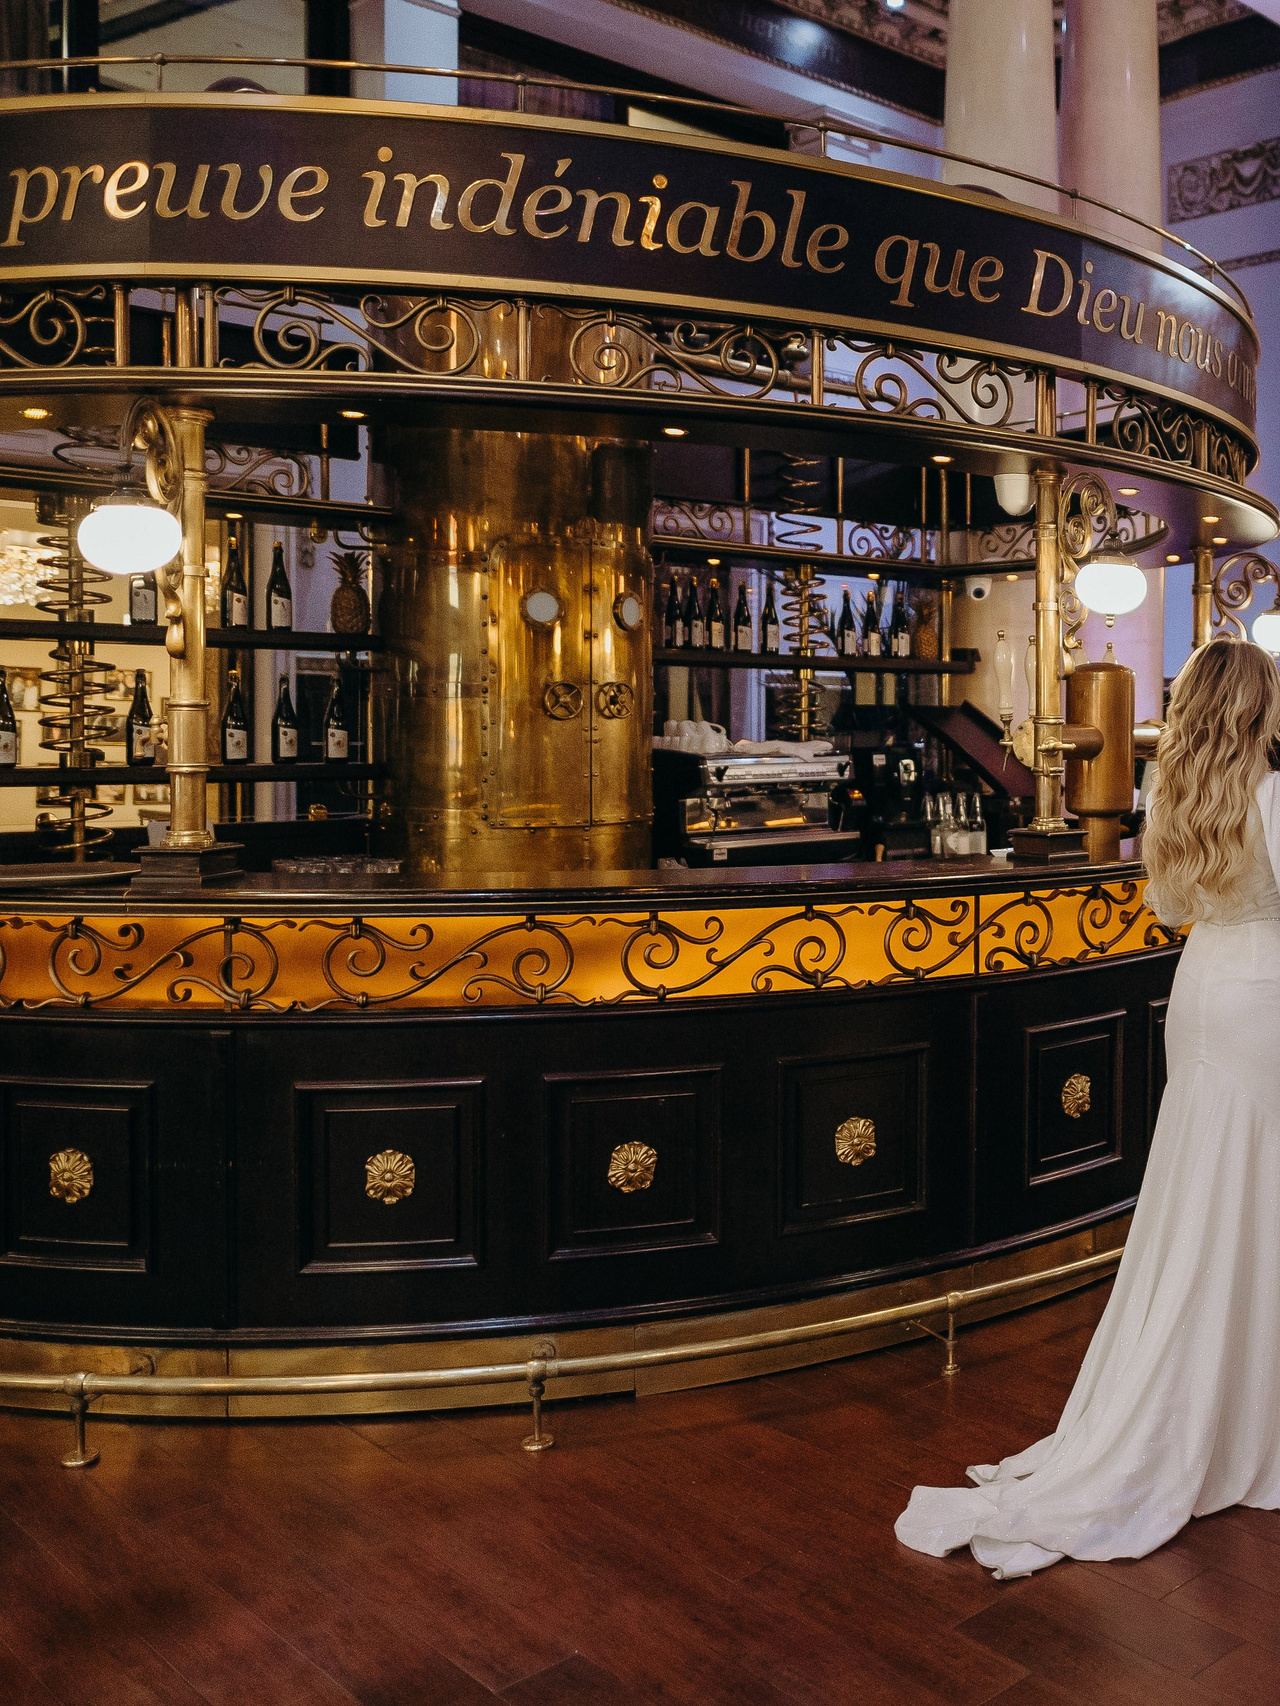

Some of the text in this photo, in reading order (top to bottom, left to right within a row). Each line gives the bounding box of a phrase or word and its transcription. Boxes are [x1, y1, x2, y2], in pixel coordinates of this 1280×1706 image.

[0, 160, 329, 247] preuve
[362, 146, 850, 274] indéniable
[875, 234, 1004, 307] que
[1021, 249, 1145, 344] Dieu
[1156, 310, 1223, 379] nous
